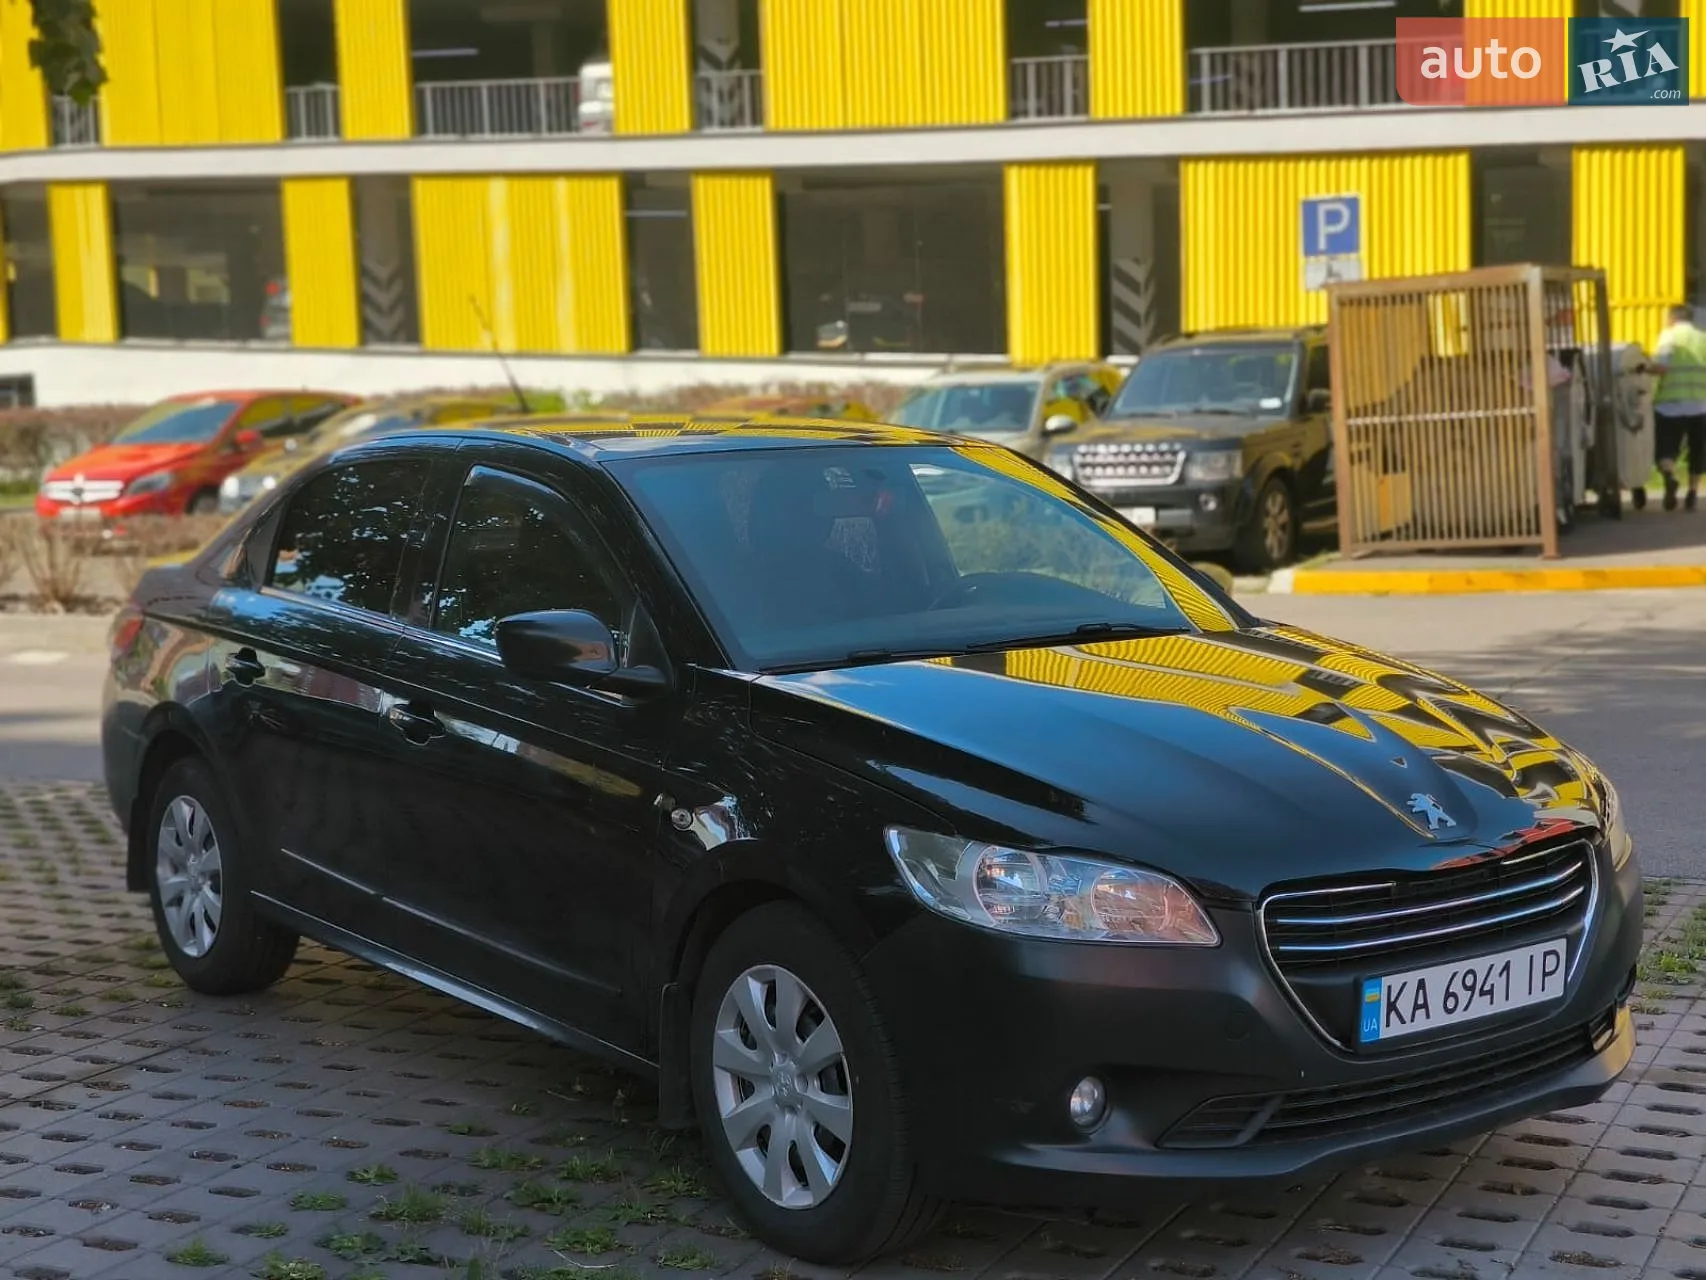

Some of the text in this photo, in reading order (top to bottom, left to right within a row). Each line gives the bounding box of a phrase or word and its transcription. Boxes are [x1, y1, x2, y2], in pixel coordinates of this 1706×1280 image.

[1318, 203, 1350, 250] P
[1385, 949, 1561, 1028] KA 6941 IP
[1363, 1019, 1378, 1032] UA
